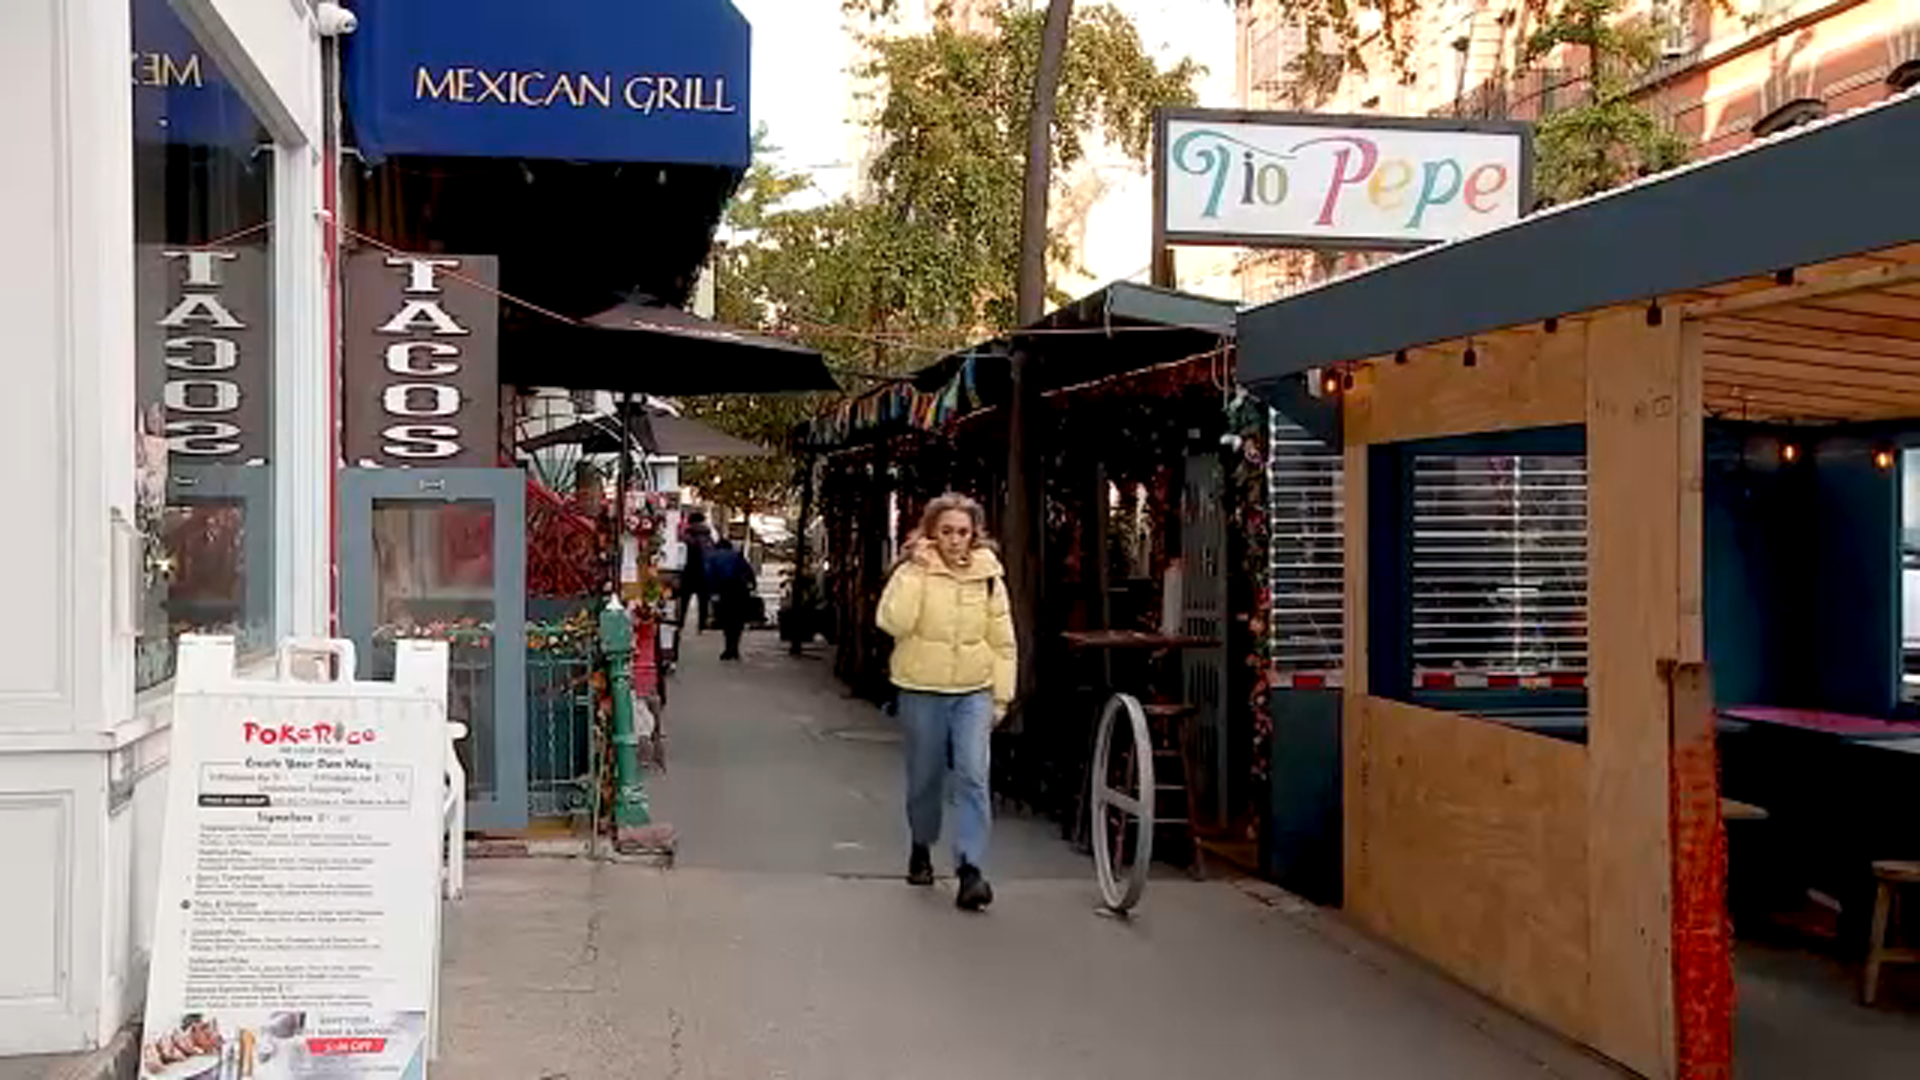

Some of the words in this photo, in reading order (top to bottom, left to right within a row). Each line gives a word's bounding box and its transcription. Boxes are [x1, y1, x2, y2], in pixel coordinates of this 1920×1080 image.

[415, 66, 612, 108] MEXICAN
[624, 74, 736, 115] GRILL
[1172, 129, 1296, 219] Tio
[1290, 136, 1508, 230] Pepe
[375, 256, 471, 458] TACOS
